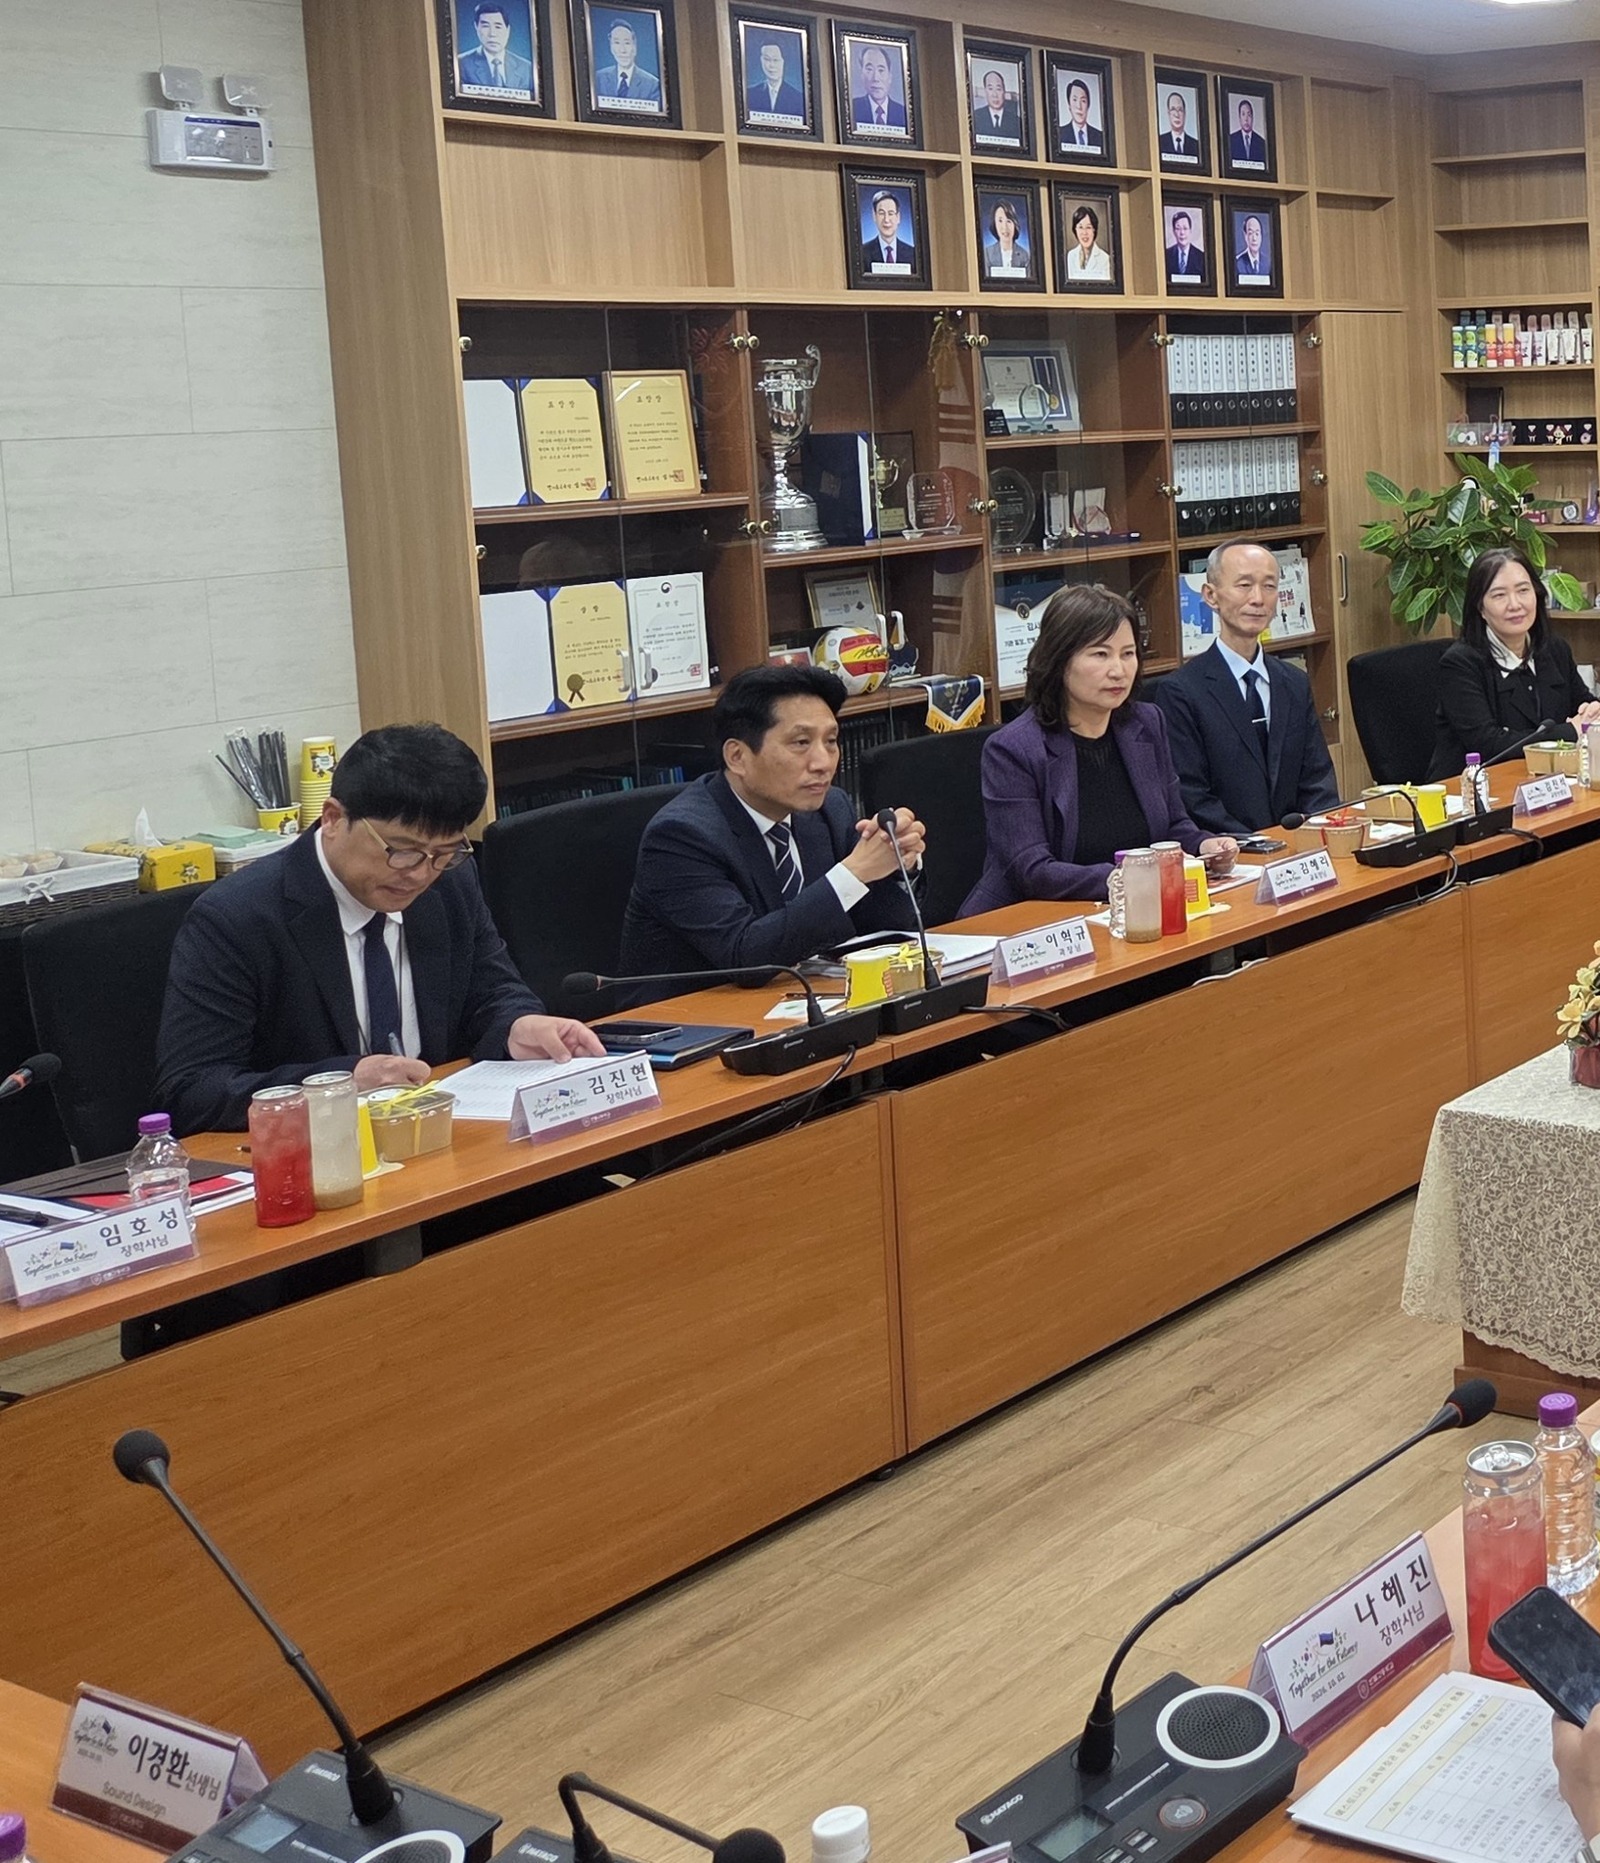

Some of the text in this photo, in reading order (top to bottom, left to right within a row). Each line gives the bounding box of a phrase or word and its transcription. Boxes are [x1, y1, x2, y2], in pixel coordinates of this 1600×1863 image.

[587, 1062, 649, 1095] 김진현
[99, 1207, 179, 1247] 임호성
[120, 1234, 170, 1258] 장학사님
[1353, 1554, 1432, 1626] 나혜진
[1379, 1600, 1426, 1648] 장학사님
[1288, 1671, 1317, 1699] Together
[1317, 1663, 1326, 1676] for
[1326, 1656, 1336, 1669] the
[128, 1734, 190, 1790] 이경환
[184, 1769, 222, 1801] 선생님
[102, 1780, 168, 1818] Sound Design
